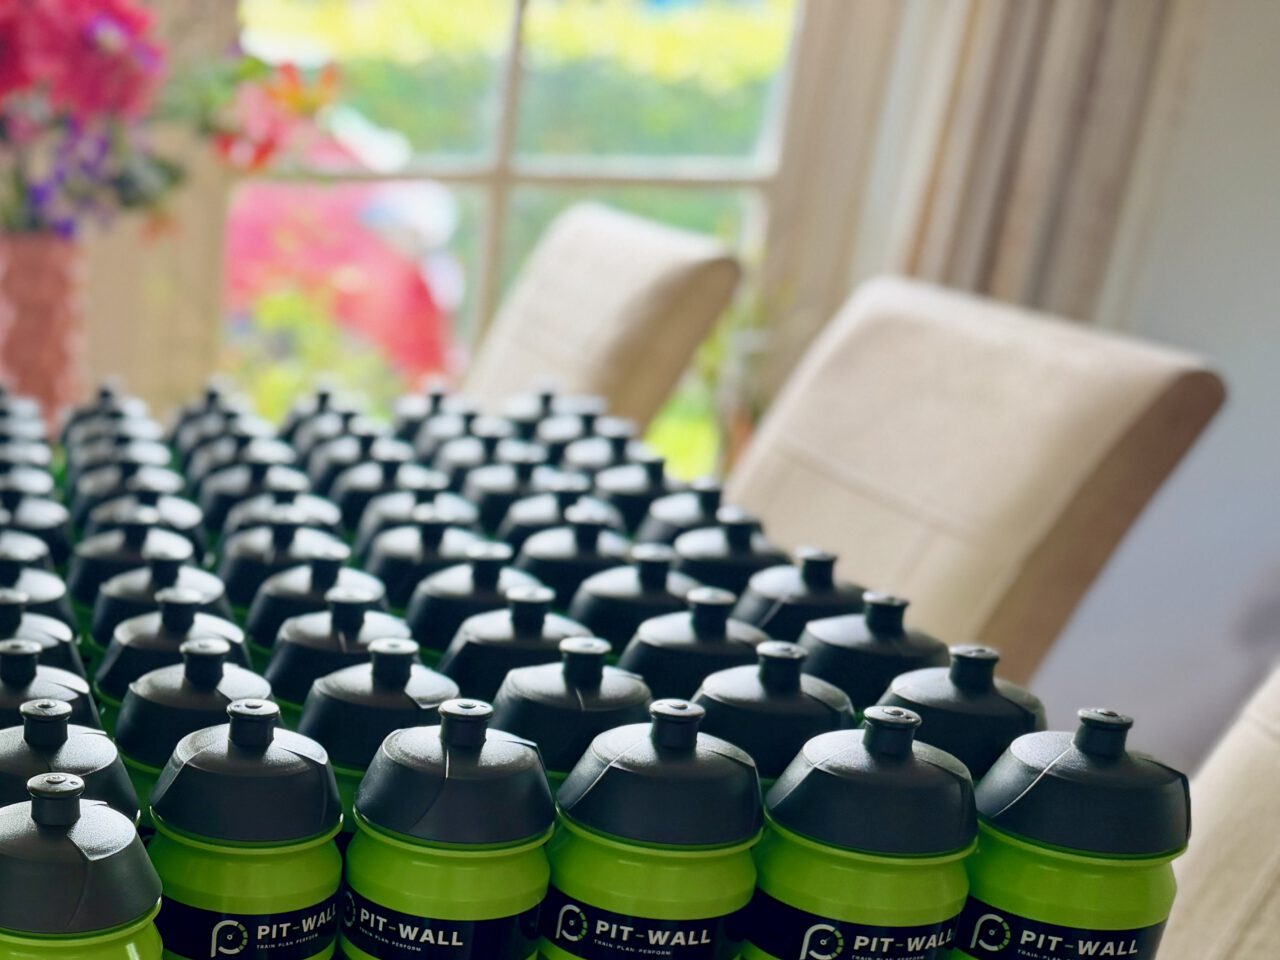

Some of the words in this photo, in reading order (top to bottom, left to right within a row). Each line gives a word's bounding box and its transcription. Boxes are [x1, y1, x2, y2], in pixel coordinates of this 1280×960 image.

[257, 903, 337, 940] PIT-WALL
[360, 908, 464, 947] PIT-WALL
[596, 920, 711, 947] PIT-WALL
[853, 928, 953, 954] PIT-WALL
[1019, 930, 1138, 957] PIT-WALL
